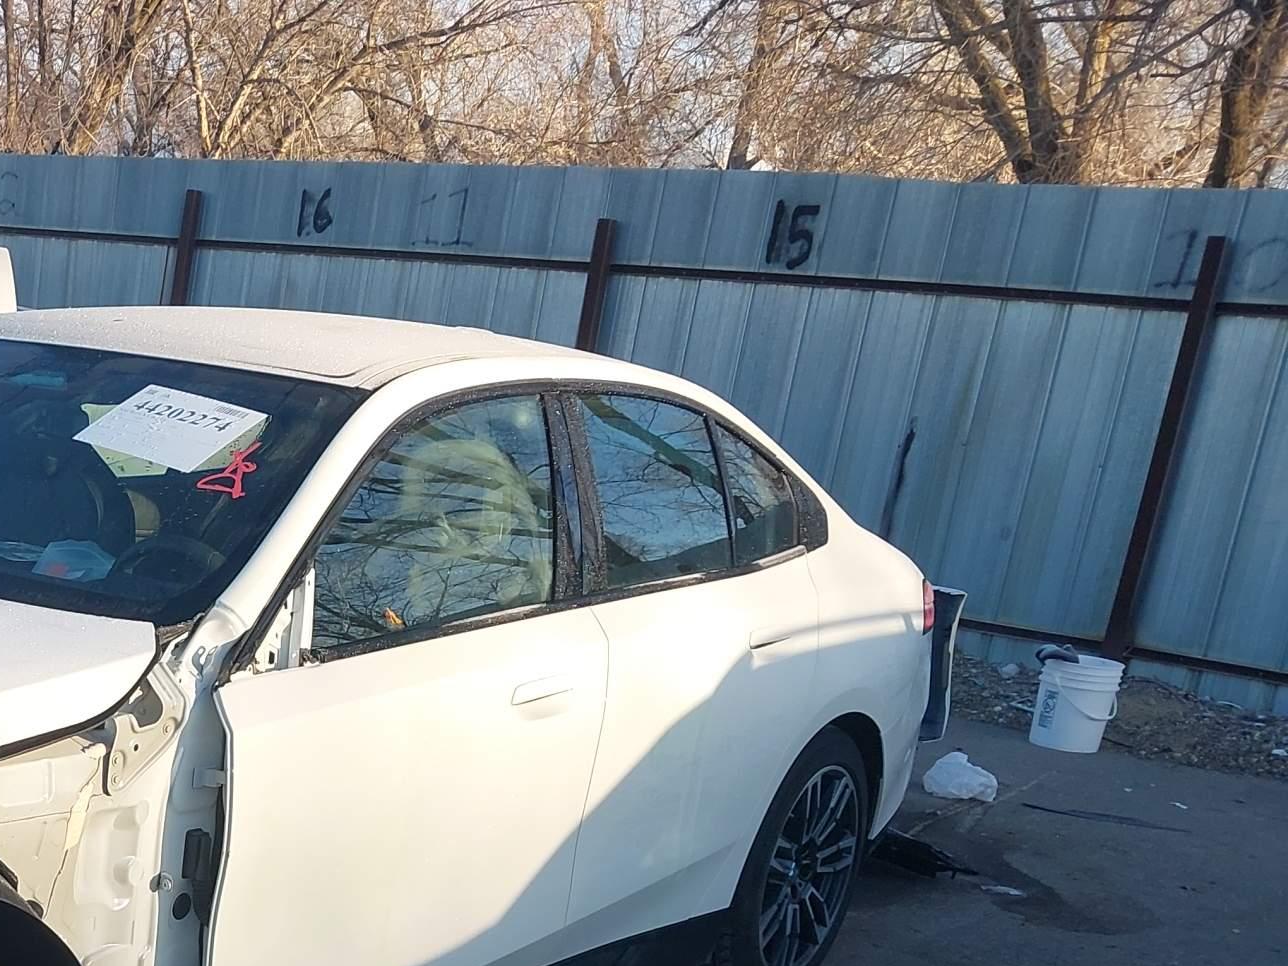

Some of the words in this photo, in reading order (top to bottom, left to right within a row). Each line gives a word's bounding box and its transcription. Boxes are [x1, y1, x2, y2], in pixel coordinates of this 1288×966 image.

[297, 187, 333, 238] 16
[765, 199, 821, 270] 15
[133, 400, 234, 432] 44202274
